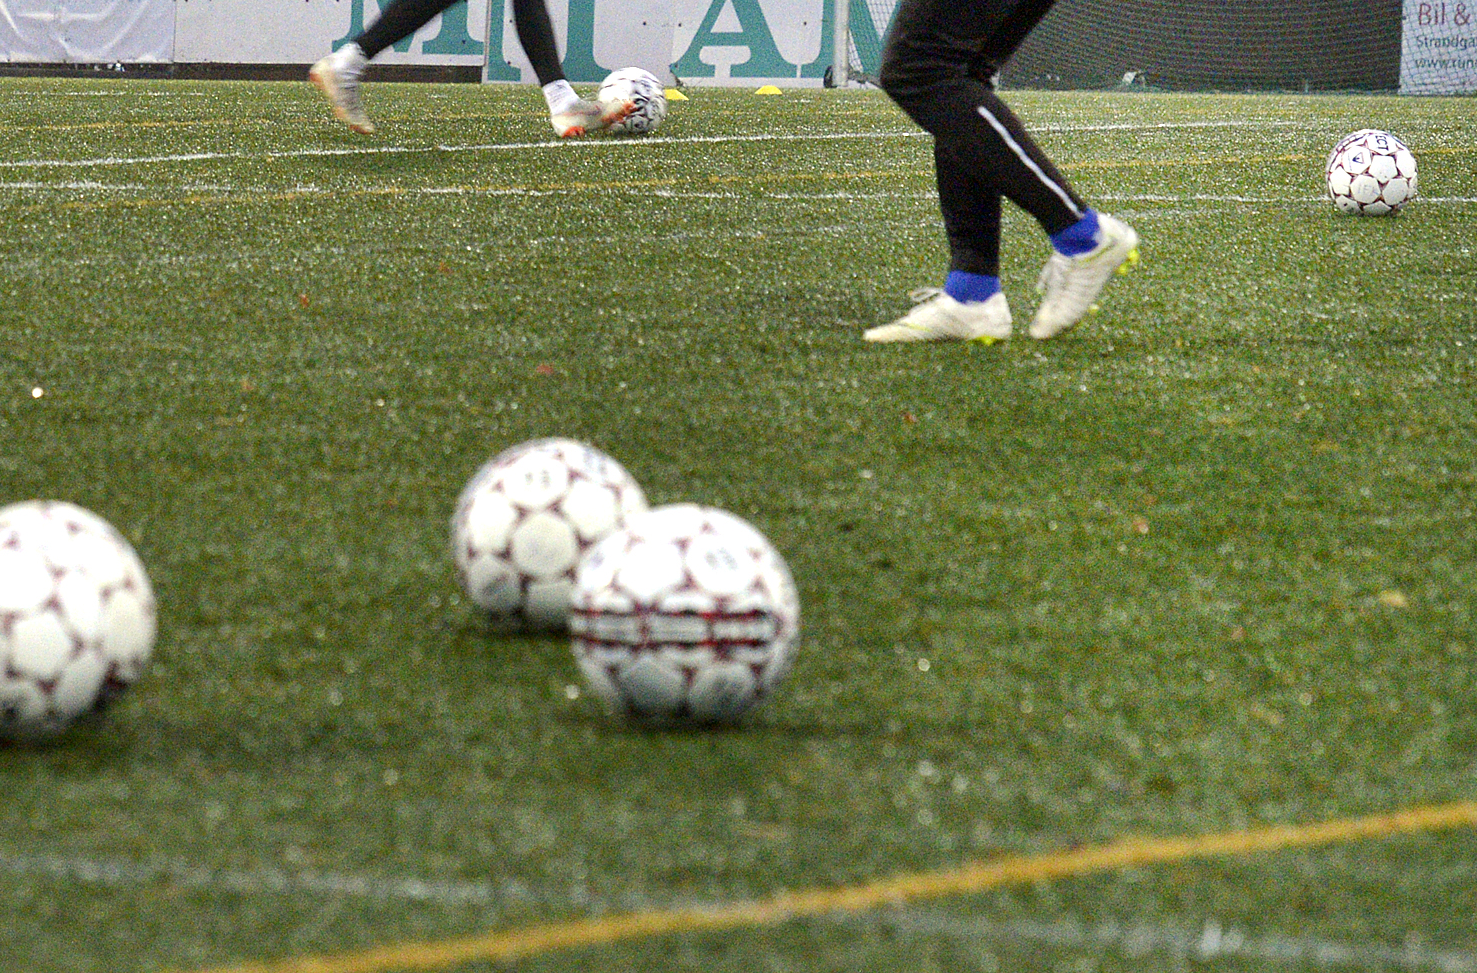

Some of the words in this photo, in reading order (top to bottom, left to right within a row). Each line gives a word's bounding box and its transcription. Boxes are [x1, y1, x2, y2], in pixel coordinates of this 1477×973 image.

[1418, 2, 1445, 26] Bil
[1454, 2, 1470, 26] &
[1415, 34, 1477, 51] Strandga
[1414, 57, 1477, 70] www.run
